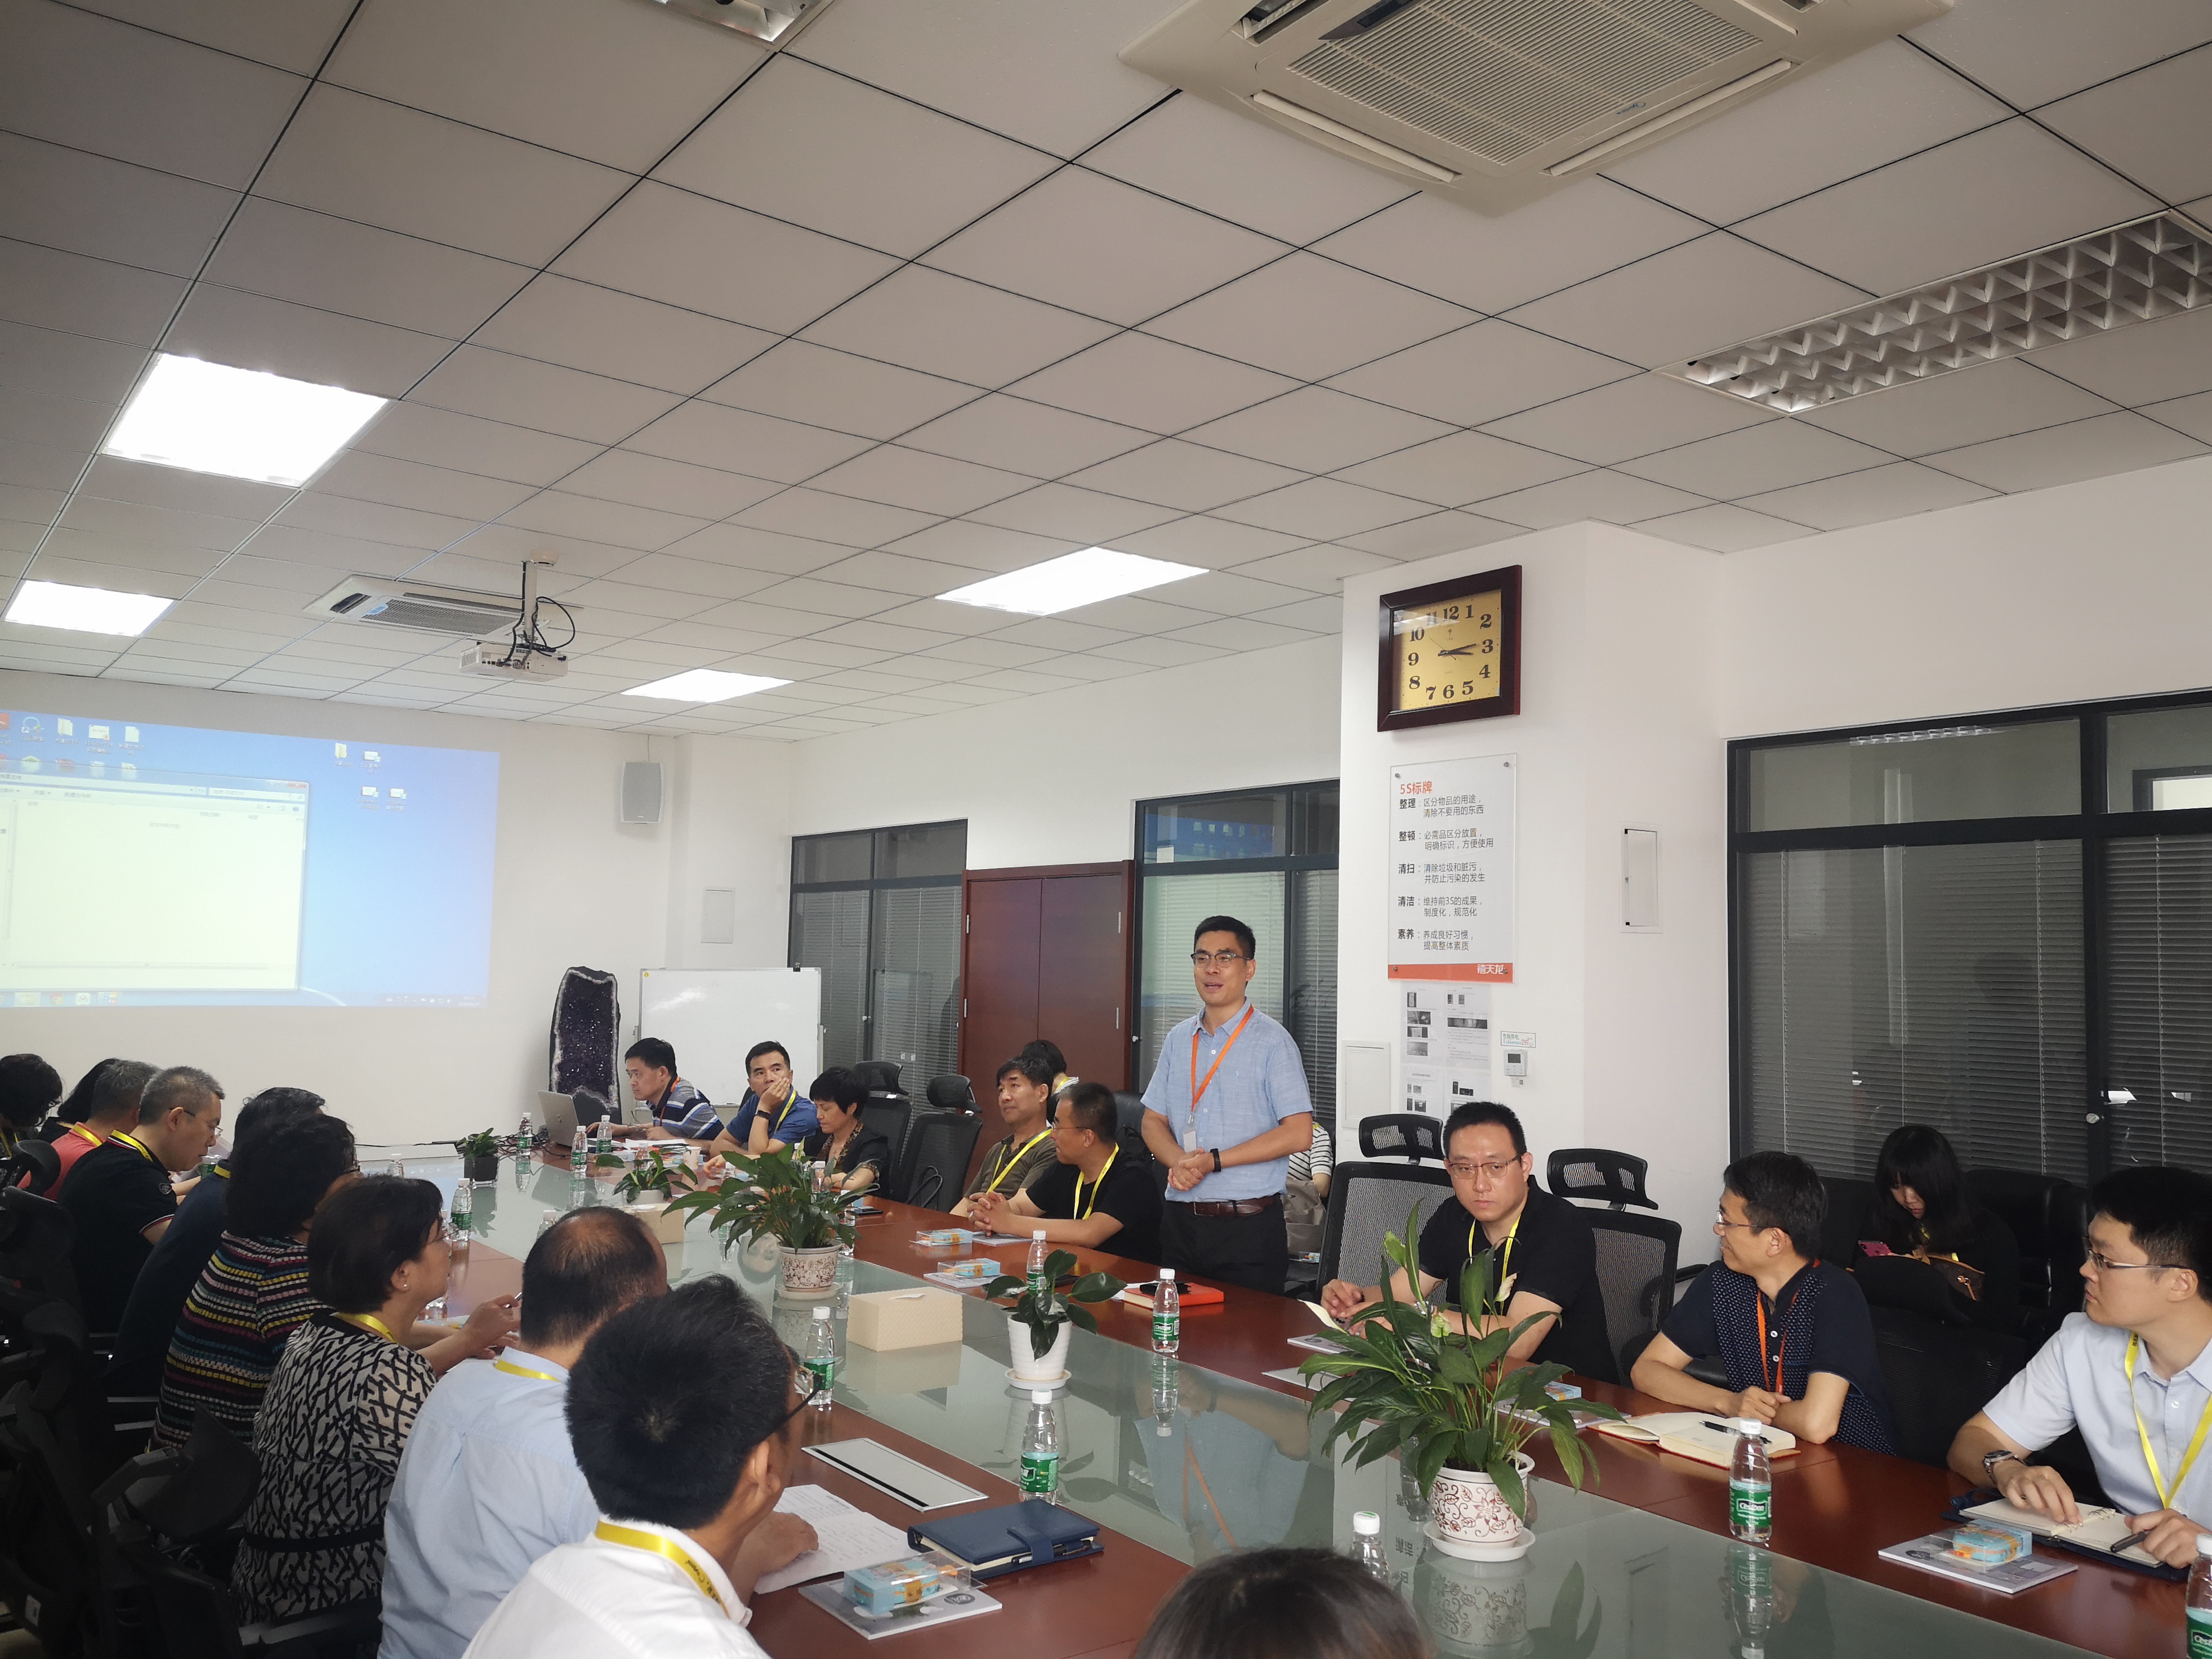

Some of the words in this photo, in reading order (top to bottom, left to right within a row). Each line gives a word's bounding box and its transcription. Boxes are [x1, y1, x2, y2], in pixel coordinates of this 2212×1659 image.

[1427, 612, 1437, 625] 11
[1443, 605, 1459, 622] 12
[1466, 604, 1474, 619] 1
[1479, 614, 1492, 629] 2
[1410, 627, 1425, 642] 10
[1482, 639, 1493, 654] 3
[1408, 652, 1419, 666] 9
[1478, 664, 1491, 679] 4
[1409, 676, 1420, 690] 8
[1462, 680, 1474, 695] 5
[1425, 686, 1437, 701] 7
[1443, 685, 1454, 699] 6
[1400, 780, 1432, 794] 5S标牌
[1423, 804, 1484, 818] 清除不要用的东西
[1424, 873, 1485, 884] 并防止污染的发生
[1423, 941, 1469, 951] 提高整体素质
